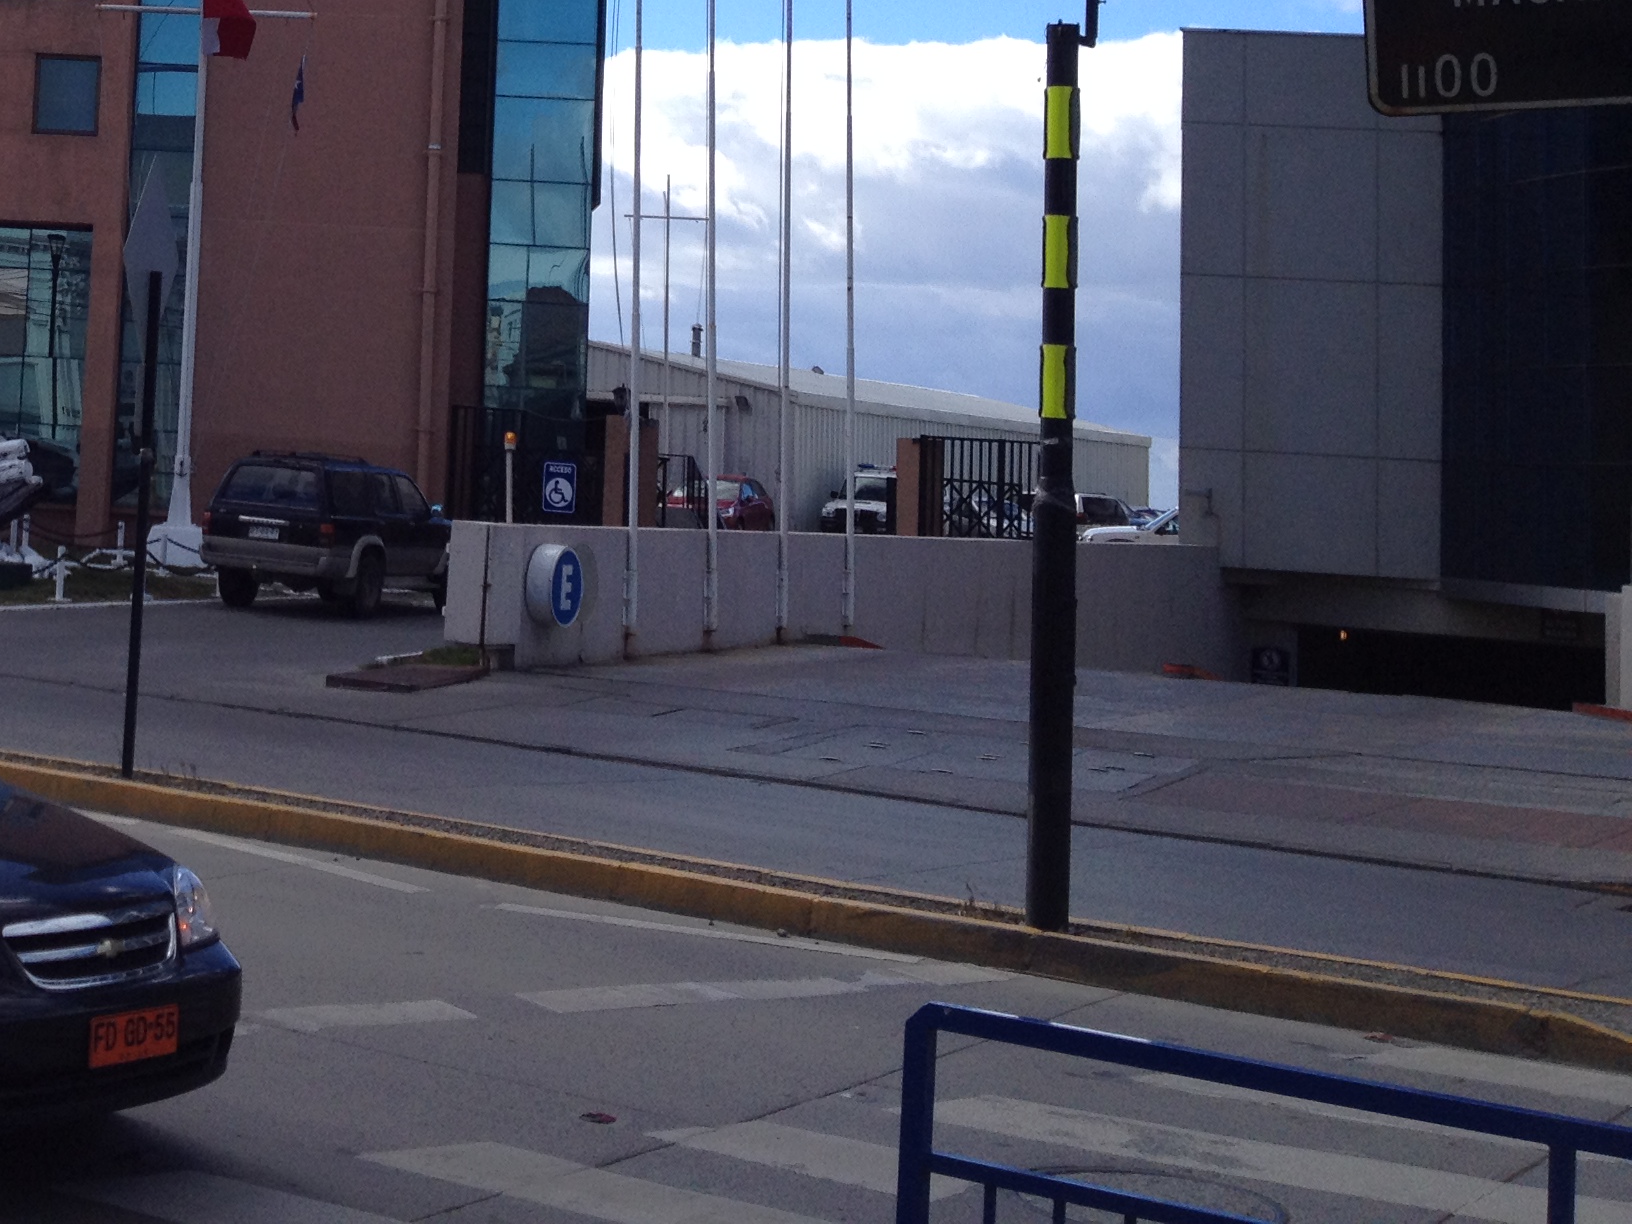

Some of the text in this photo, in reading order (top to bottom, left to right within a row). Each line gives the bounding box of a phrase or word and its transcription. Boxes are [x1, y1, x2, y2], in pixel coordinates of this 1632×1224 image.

[1401, 52, 1499, 99] 1100
[548, 465, 572, 474] ACCESO
[560, 564, 574, 611] E
